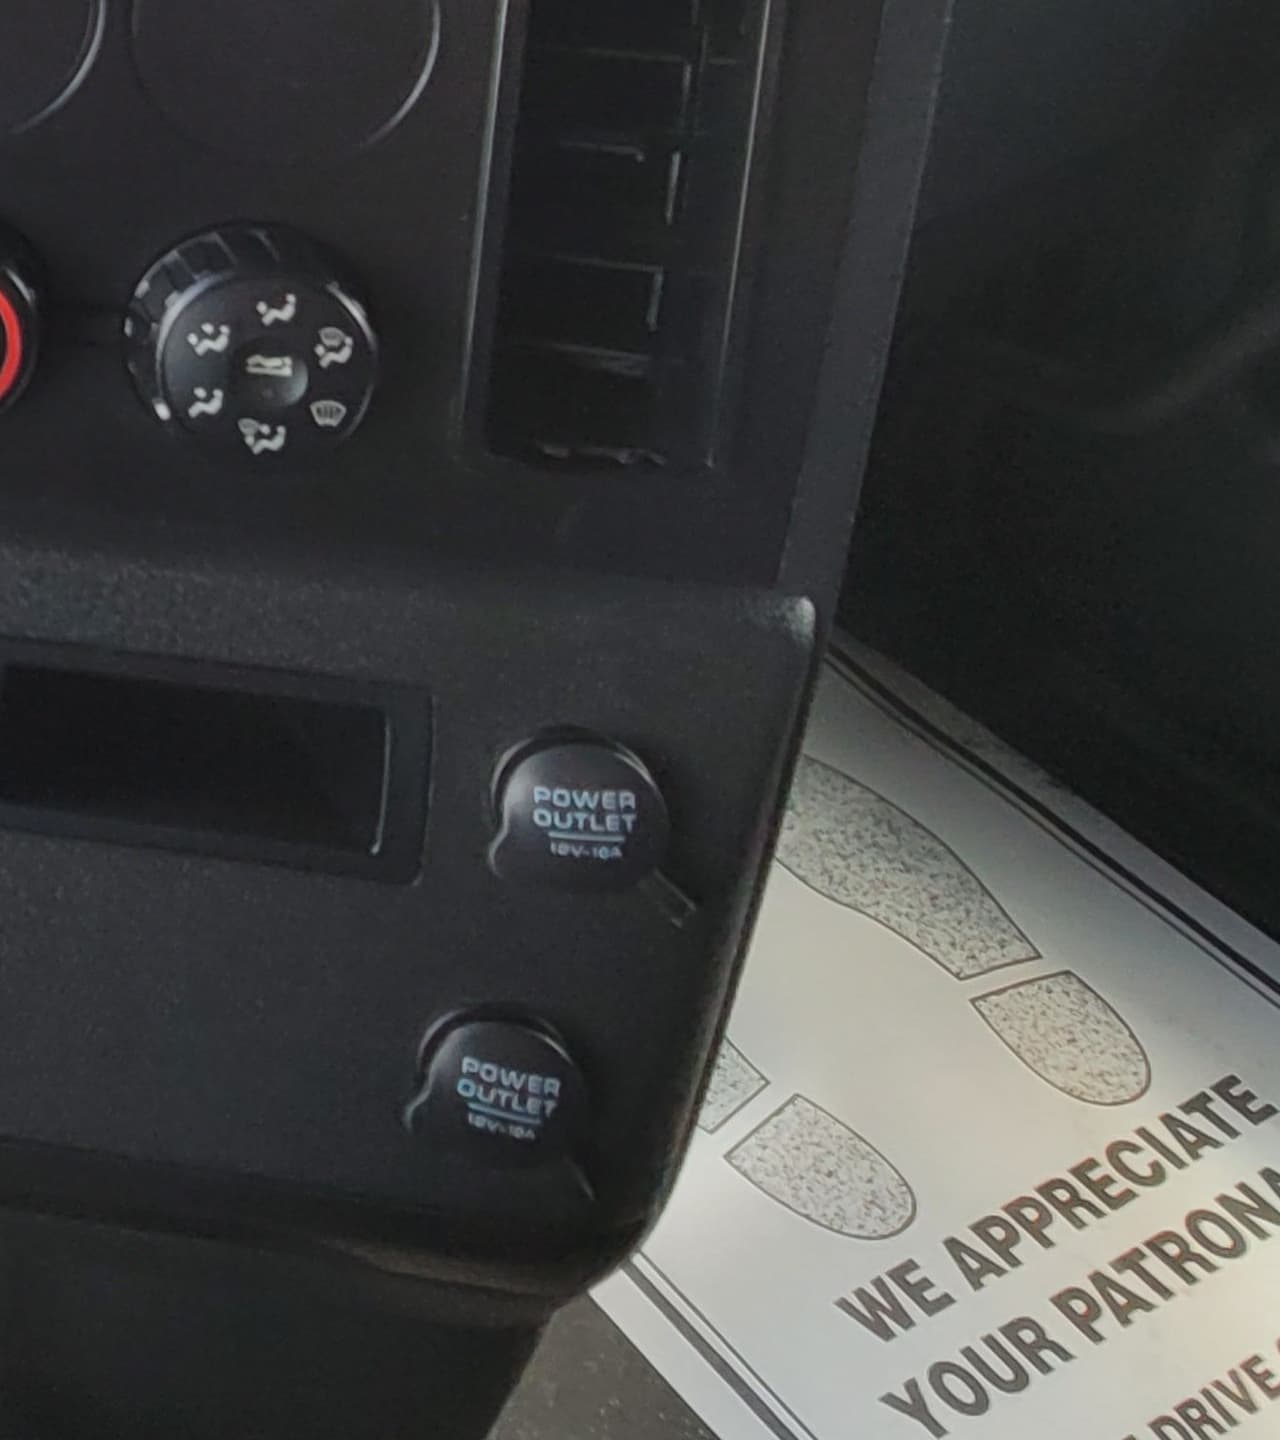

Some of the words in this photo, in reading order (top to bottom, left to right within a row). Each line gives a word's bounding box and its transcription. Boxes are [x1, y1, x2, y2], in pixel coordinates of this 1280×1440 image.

[533, 785, 637, 810] POWER
[532, 808, 637, 833] OUTLET
[456, 1077, 559, 1118] OUTLET
[461, 1055, 562, 1098] POWER
[833, 1257, 958, 1344] WE
[941, 1074, 1280, 1293] APPRECIATE
[877, 1315, 1079, 1440] YOUR
